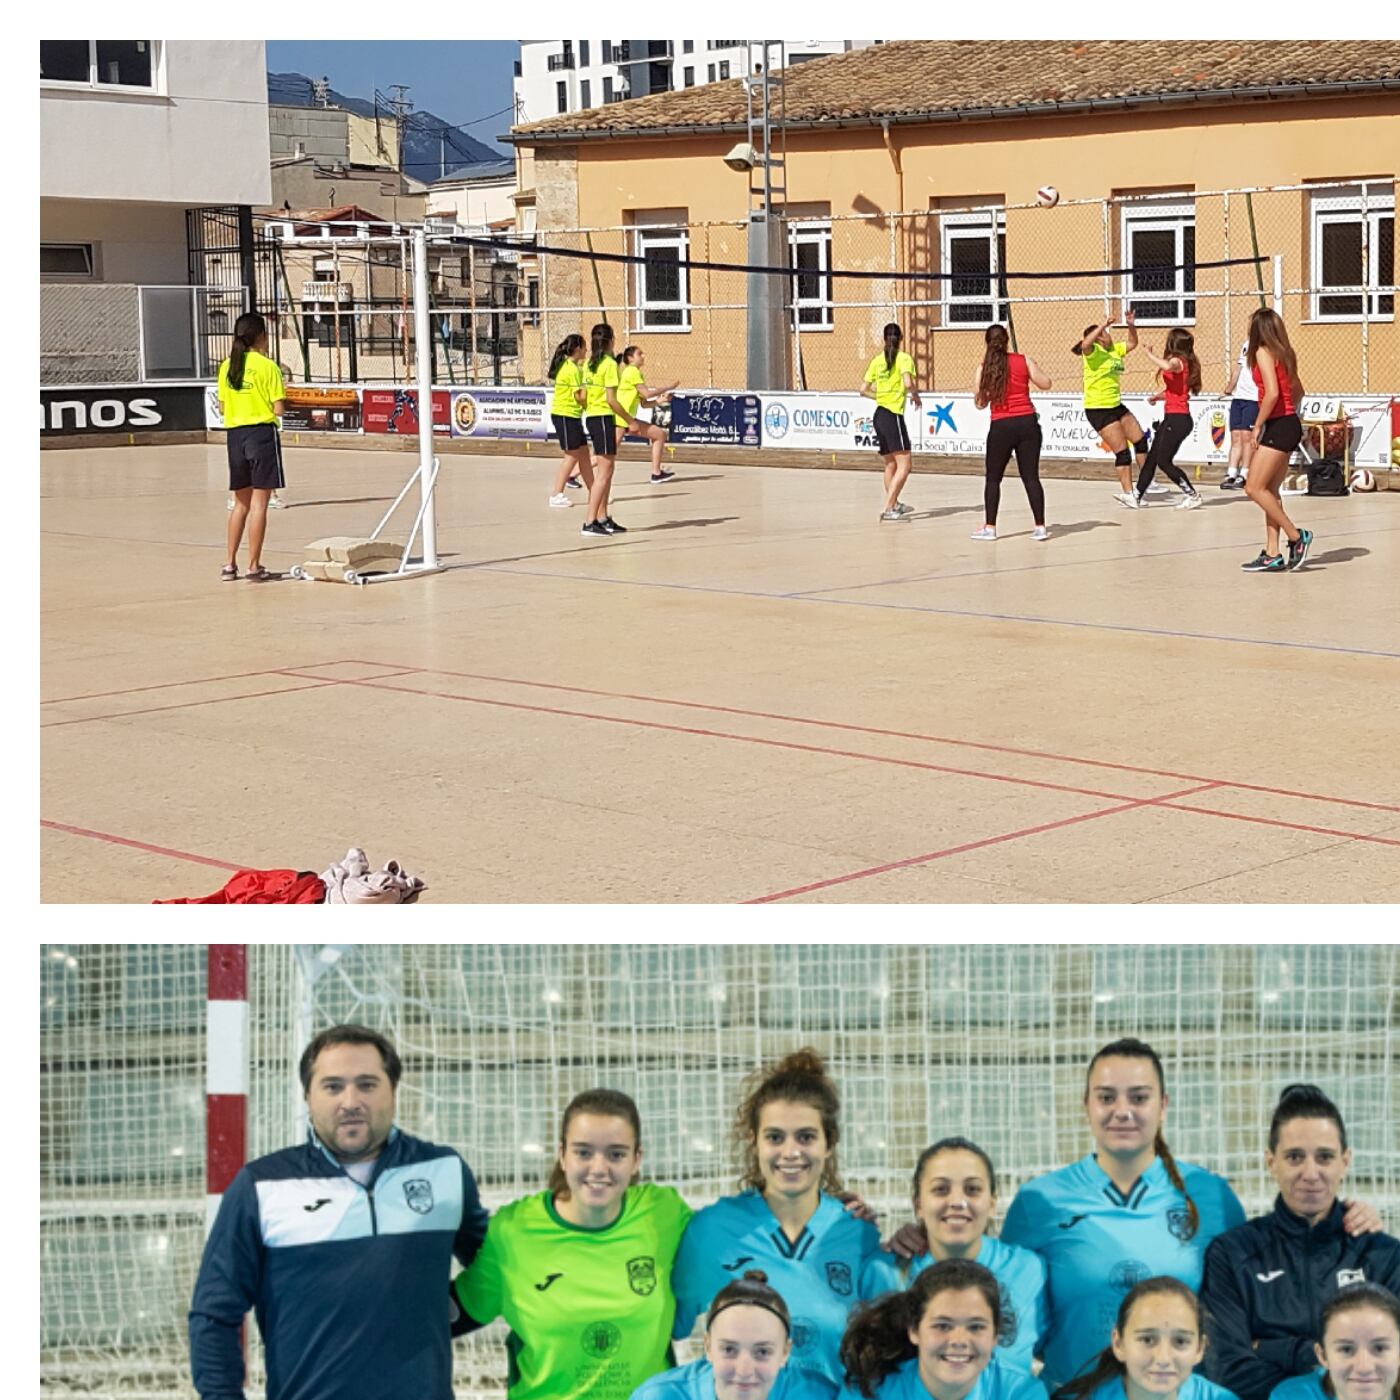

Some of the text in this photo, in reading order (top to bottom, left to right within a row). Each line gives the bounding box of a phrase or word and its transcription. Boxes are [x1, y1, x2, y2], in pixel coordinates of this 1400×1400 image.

[39, 398, 162, 430] nos
[793, 409, 850, 428] COMESCO
[924, 440, 948, 451] Social
